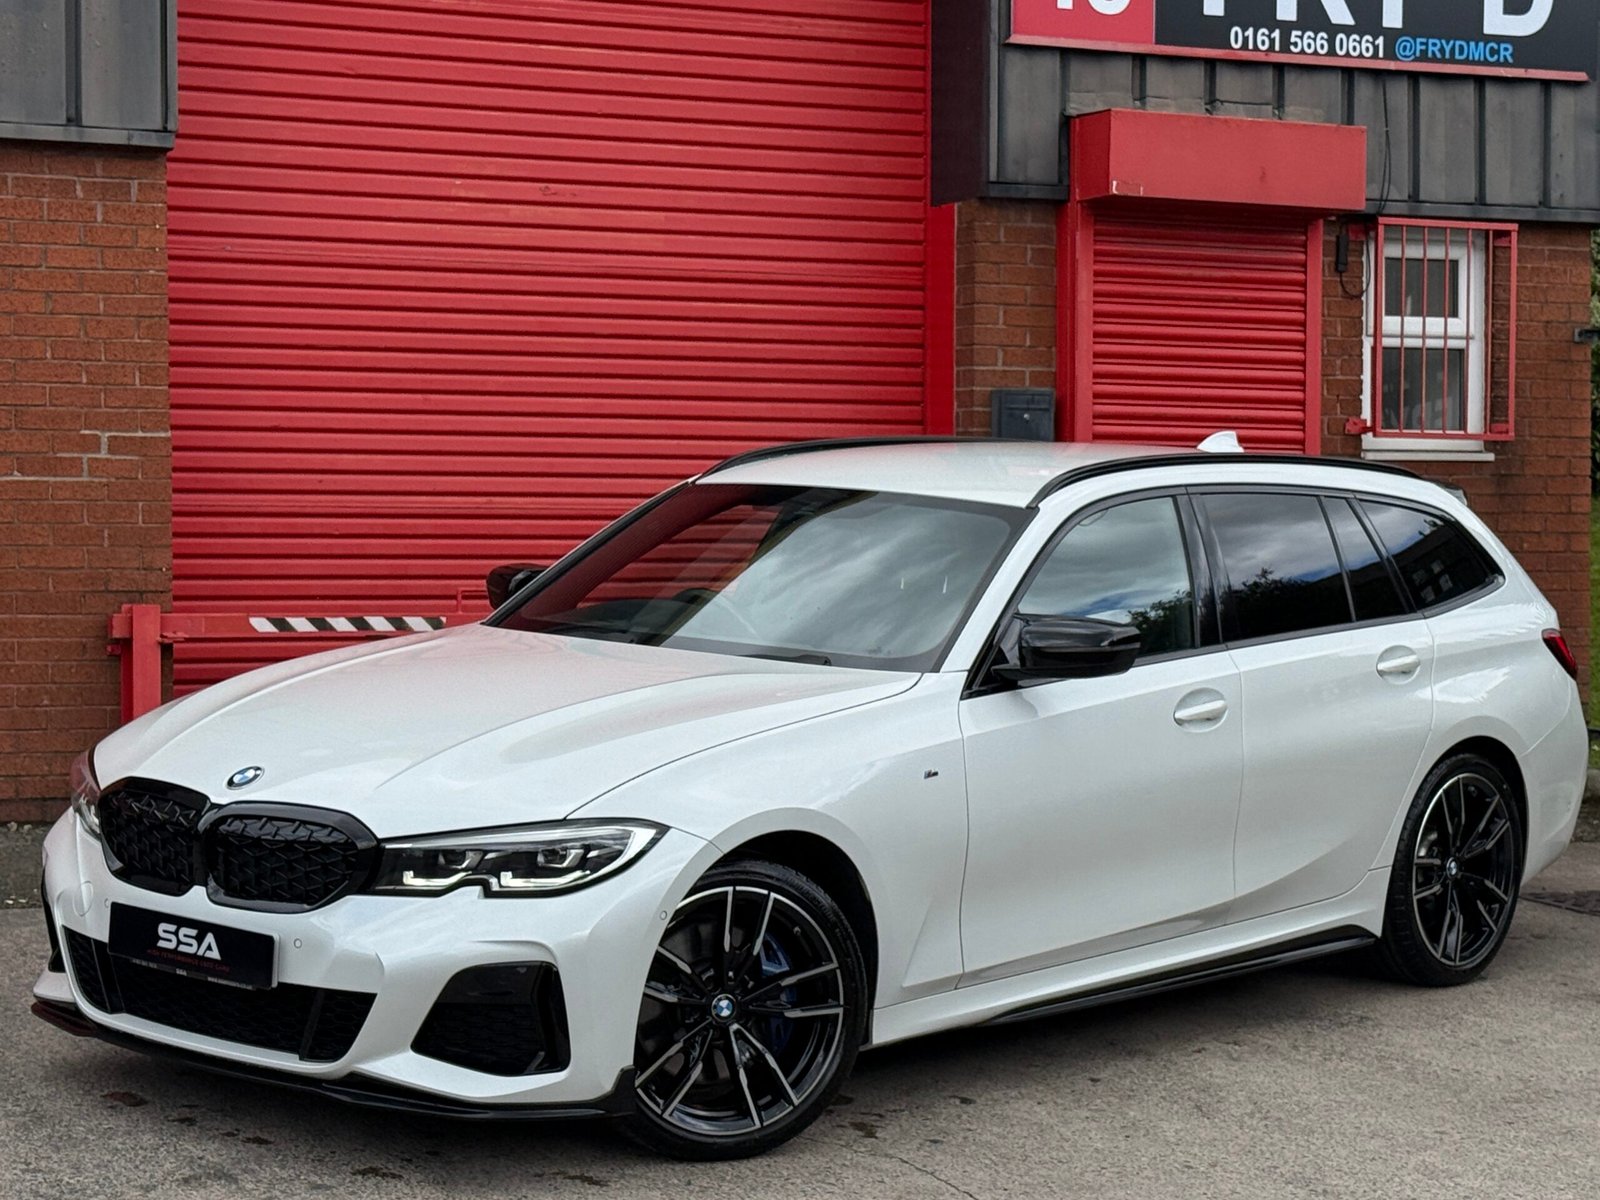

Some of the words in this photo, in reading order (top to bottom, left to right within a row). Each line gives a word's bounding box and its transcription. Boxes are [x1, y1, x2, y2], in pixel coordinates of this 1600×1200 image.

[1230, 26, 1280, 51] 0161
[1289, 30, 1328, 55] 566
[1335, 33, 1384, 58] 0661
[1395, 36, 1513, 63] @FRYDMCR
[157, 923, 221, 960] SSA
